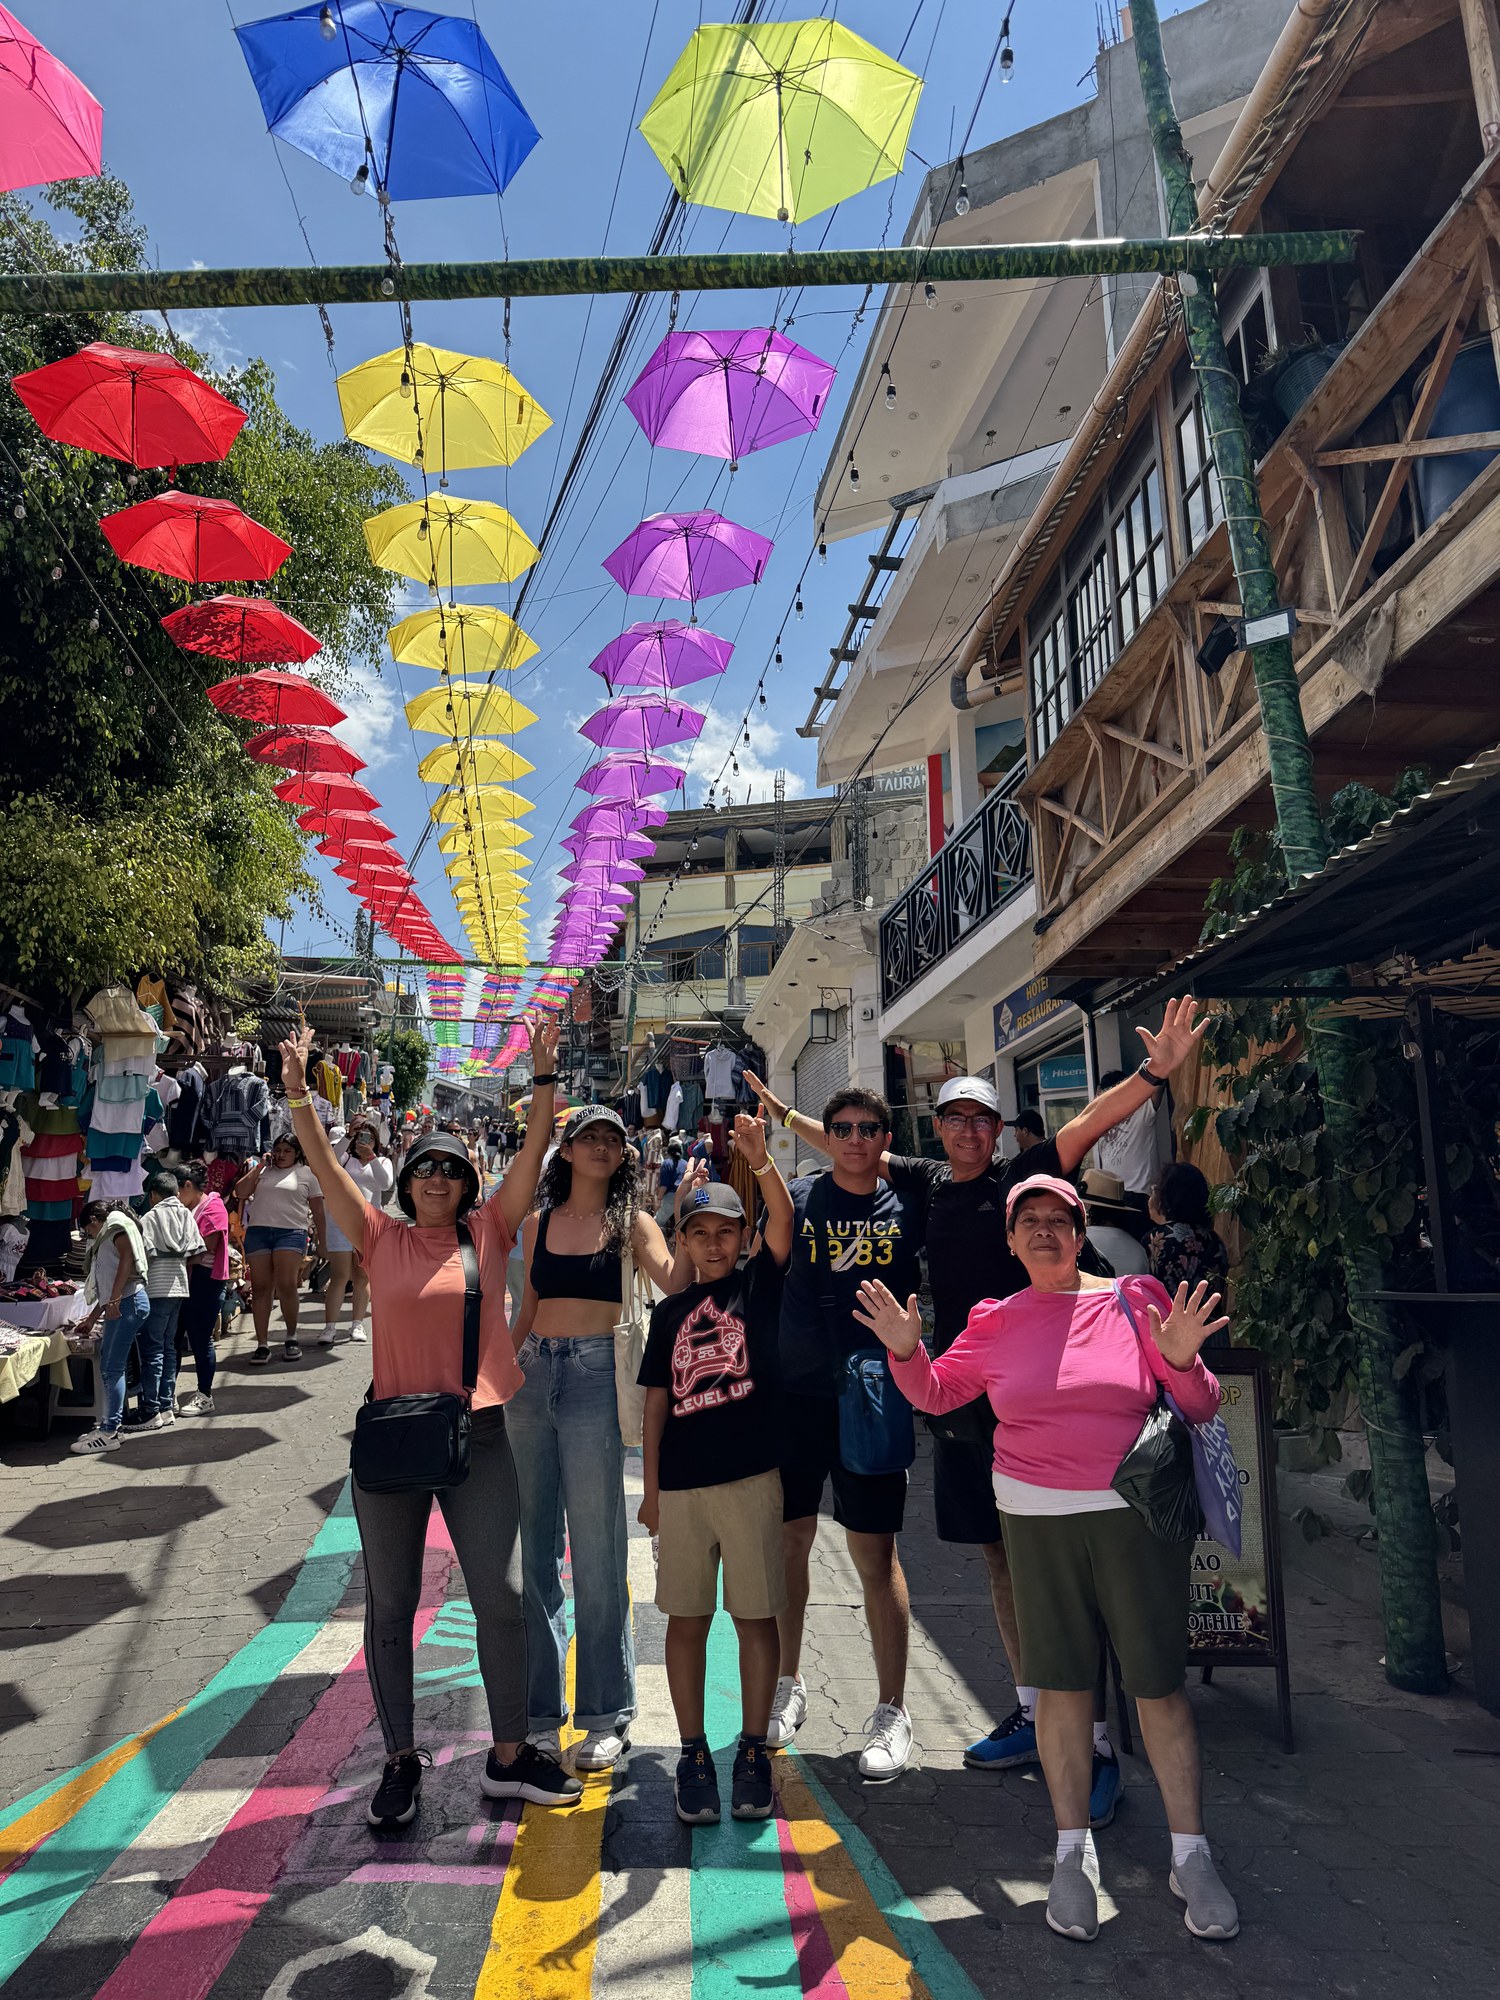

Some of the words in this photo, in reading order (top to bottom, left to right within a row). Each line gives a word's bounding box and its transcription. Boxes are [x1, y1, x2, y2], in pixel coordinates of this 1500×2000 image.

[575, 1105, 596, 1120] NEW
[674, 1390, 728, 1415] LEVEL
[730, 1381, 753, 1397] UP
[1219, 1385, 1242, 1405] OP
[1191, 1553, 1221, 1572] AO
[1187, 1613, 1246, 1632] OTHIE
